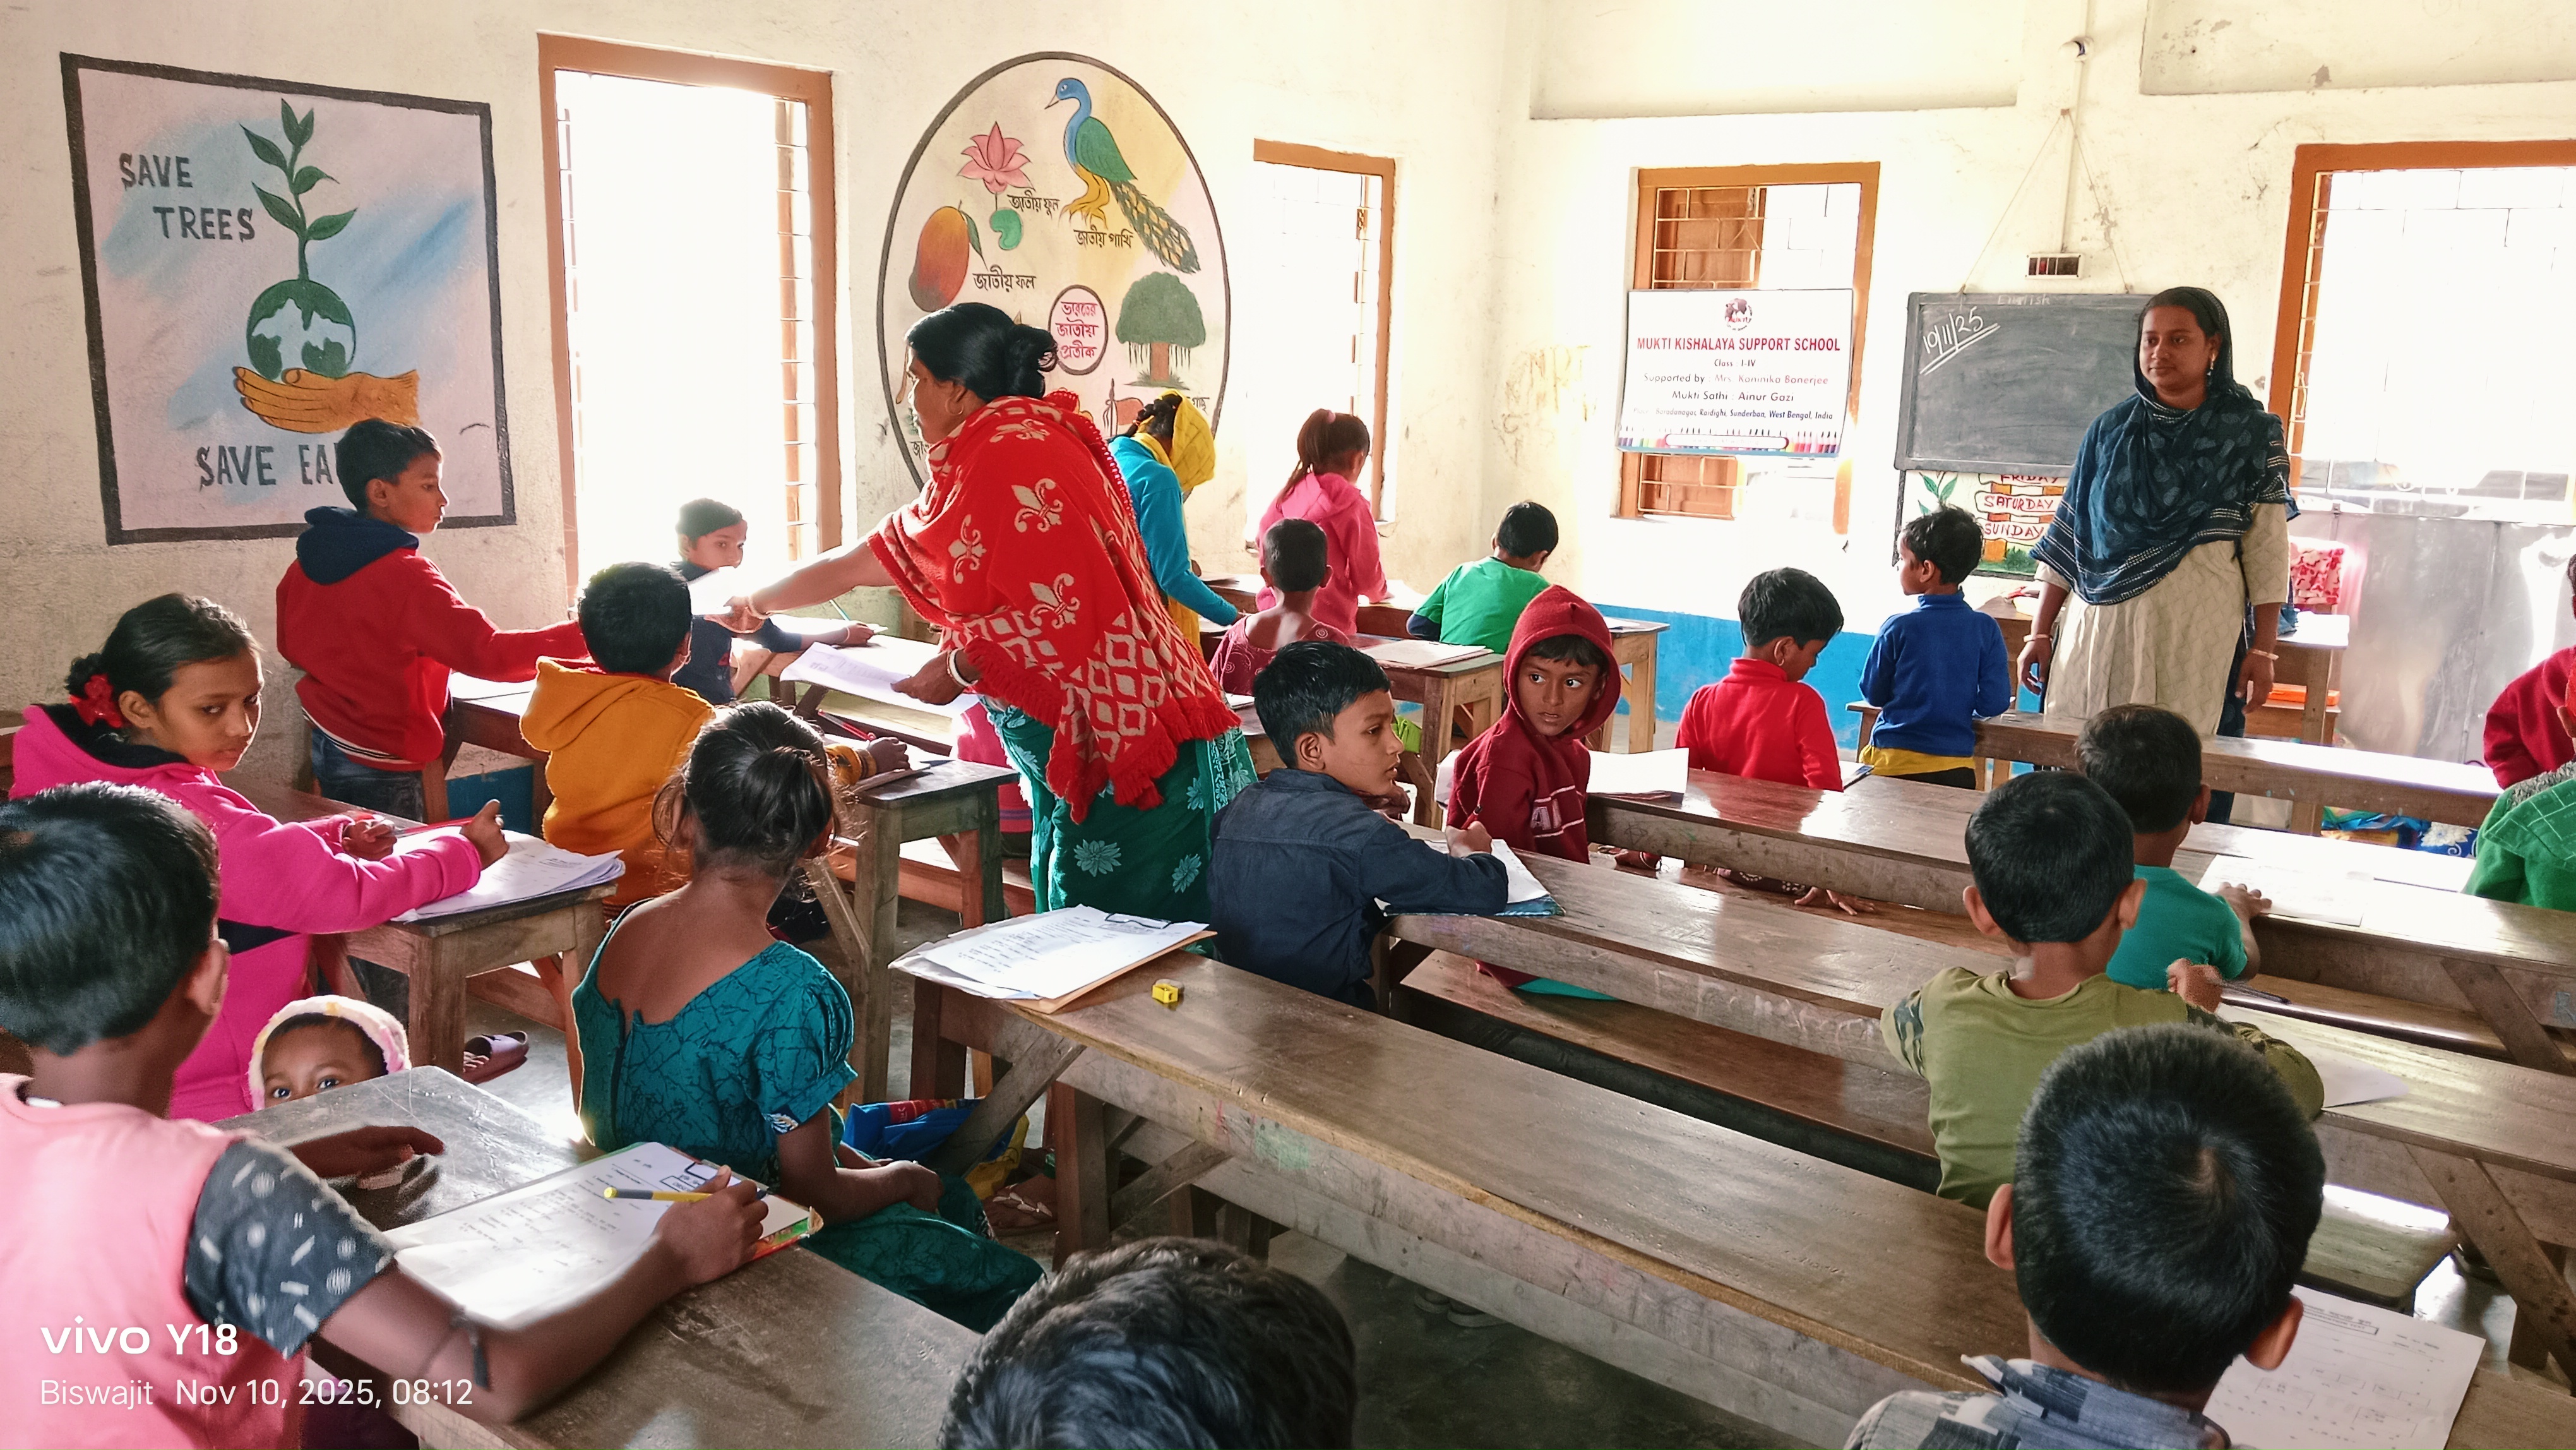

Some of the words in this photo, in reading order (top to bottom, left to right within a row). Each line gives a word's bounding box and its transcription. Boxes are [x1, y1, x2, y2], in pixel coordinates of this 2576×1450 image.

[120, 152, 193, 188] SAVE
[153, 207, 256, 241] TREES
[972, 264, 1014, 292] জাতীয়
[1015, 274, 1037, 289] ফল
[1055, 317, 1099, 338] জাতীয়
[1923, 306, 1983, 355] 10/11/25
[1059, 340, 1097, 359] প্রতীক
[1637, 337, 1671, 350] MUKTI
[1675, 337, 1735, 351] KISHALAYA
[1739, 338, 1791, 351] SUPPORT
[1794, 338, 1840, 351] SCHOOL
[1714, 359, 1733, 367] Class
[1644, 373, 1691, 383] Supported
[1695, 373, 1705, 384] by
[1785, 374, 1828, 386] Banerjee
[1673, 390, 1699, 399] Mukti
[1703, 391, 1728, 400] Sathi
[1738, 392, 1767, 400] Ainur
[1770, 392, 1794, 401] Gazi
[196, 445, 277, 491] SAVE
[1984, 495, 2054, 512] SATURDAY
[1984, 522, 2044, 539] SUNDAY
